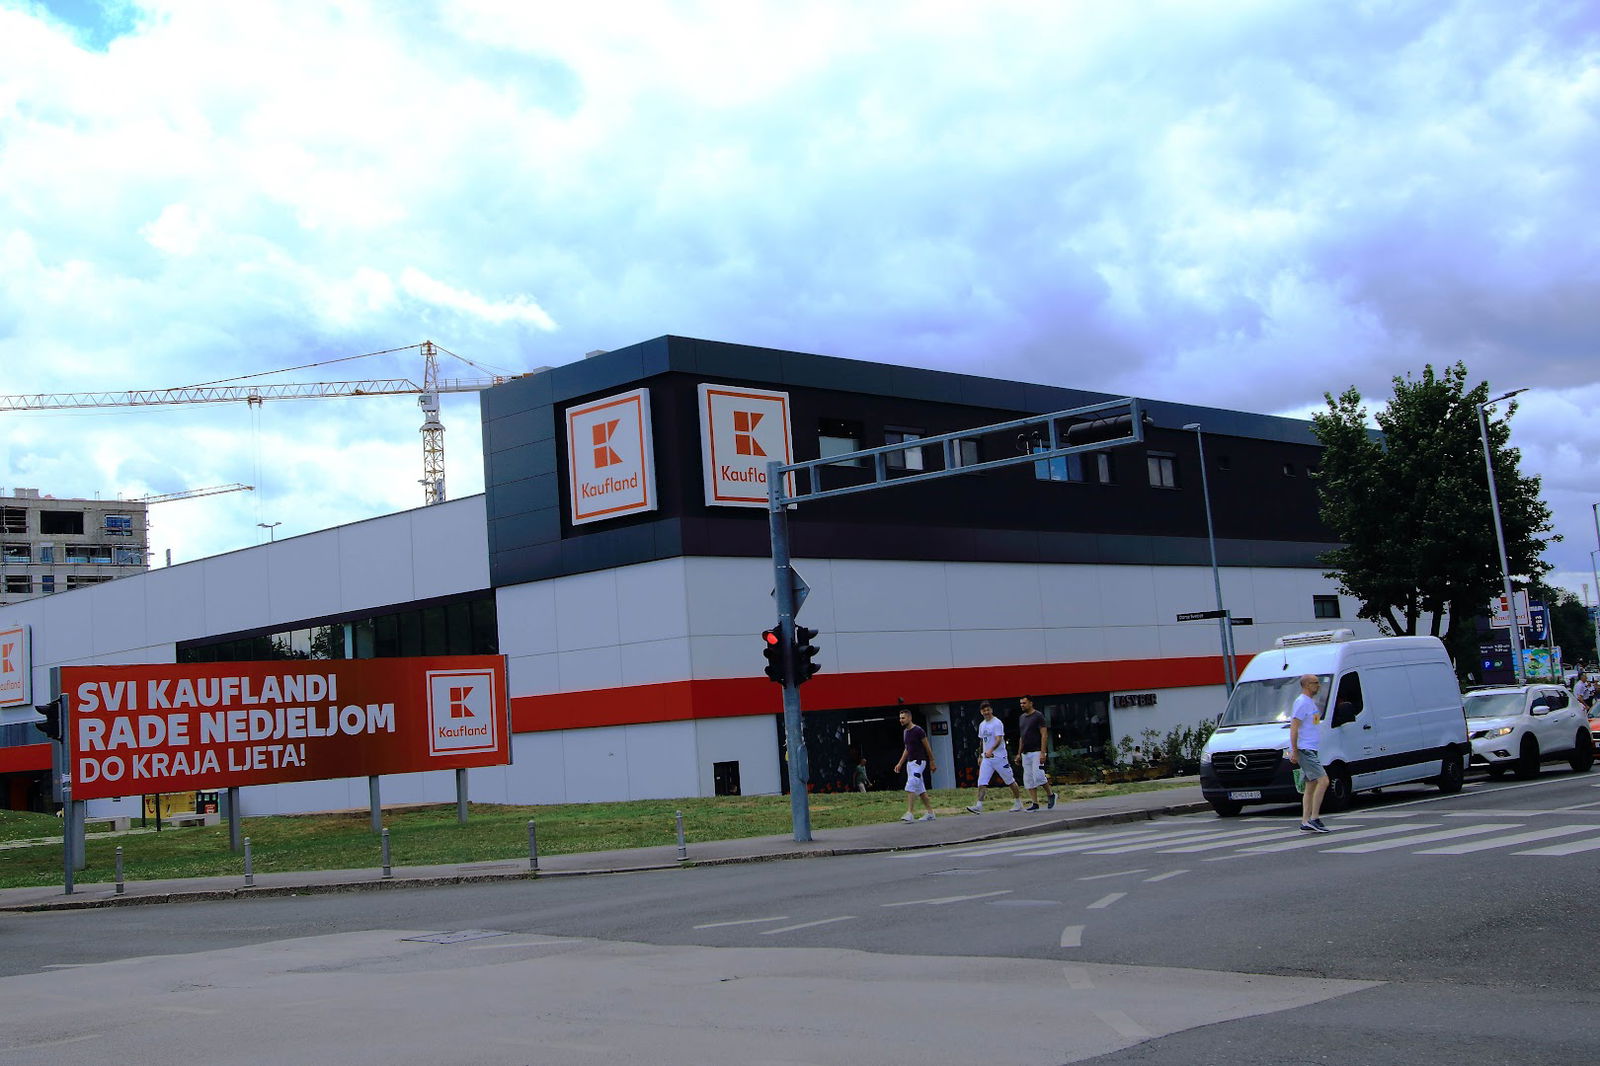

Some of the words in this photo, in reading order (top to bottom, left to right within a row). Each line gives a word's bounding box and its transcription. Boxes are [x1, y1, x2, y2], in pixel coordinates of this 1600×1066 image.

[581, 472, 638, 498] Kaufland
[721, 465, 767, 483] Kaufla
[78, 680, 137, 713] SVI
[148, 674, 337, 711] KAUFLANDI
[79, 714, 190, 752] RADE
[200, 704, 396, 744] NEDJELJOM
[439, 724, 487, 737] Kaufland
[79, 755, 125, 784] DO
[133, 750, 221, 779] KRAJA
[228, 743, 307, 773] LJETA!
